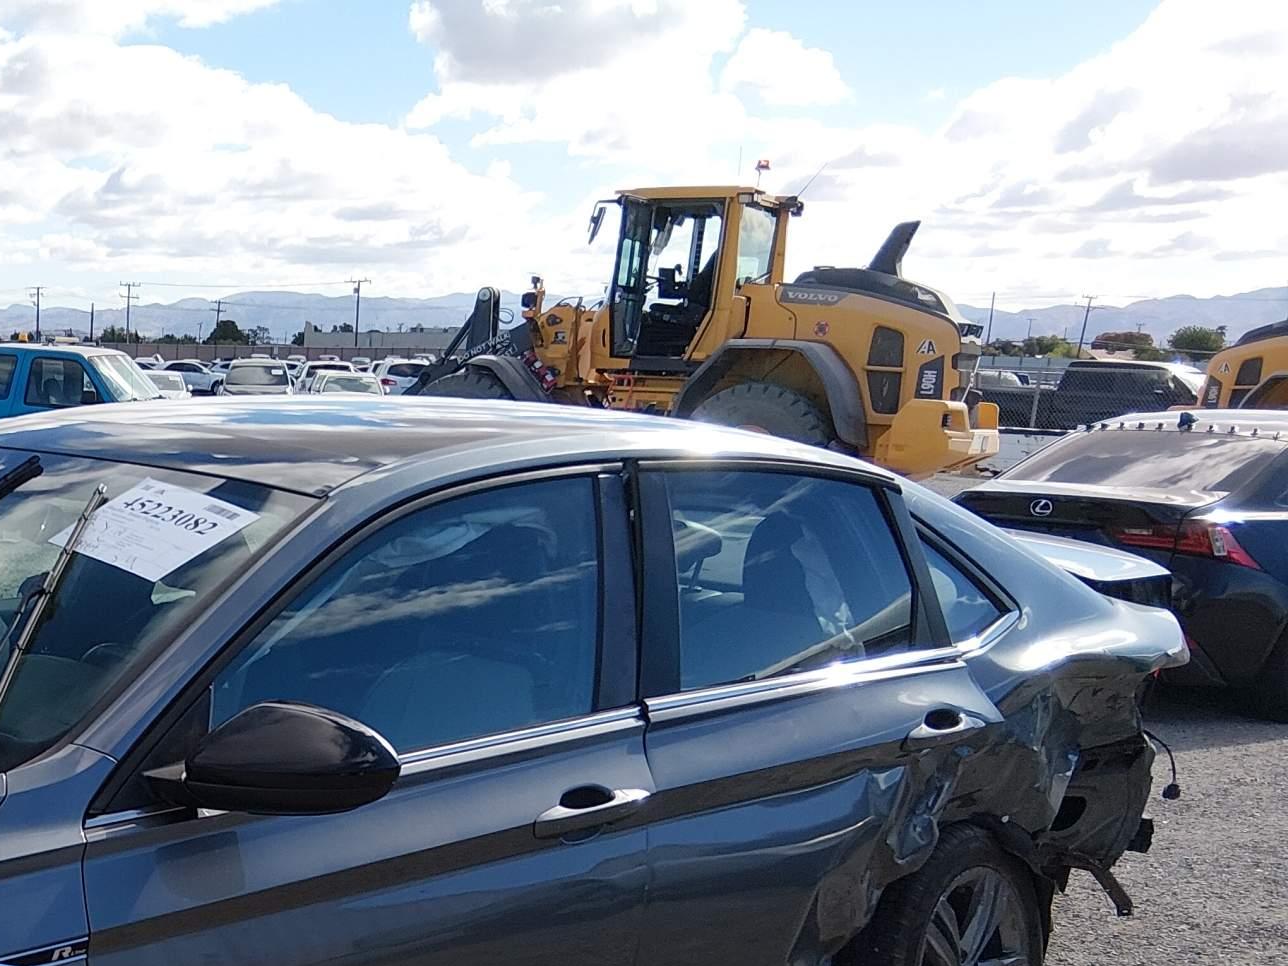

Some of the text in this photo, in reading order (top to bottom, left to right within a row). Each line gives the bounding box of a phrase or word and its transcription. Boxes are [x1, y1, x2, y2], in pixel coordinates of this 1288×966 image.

[787, 291, 838, 302] VOLVO
[919, 370, 938, 395] L90H
[123, 497, 218, 535] 45223082
